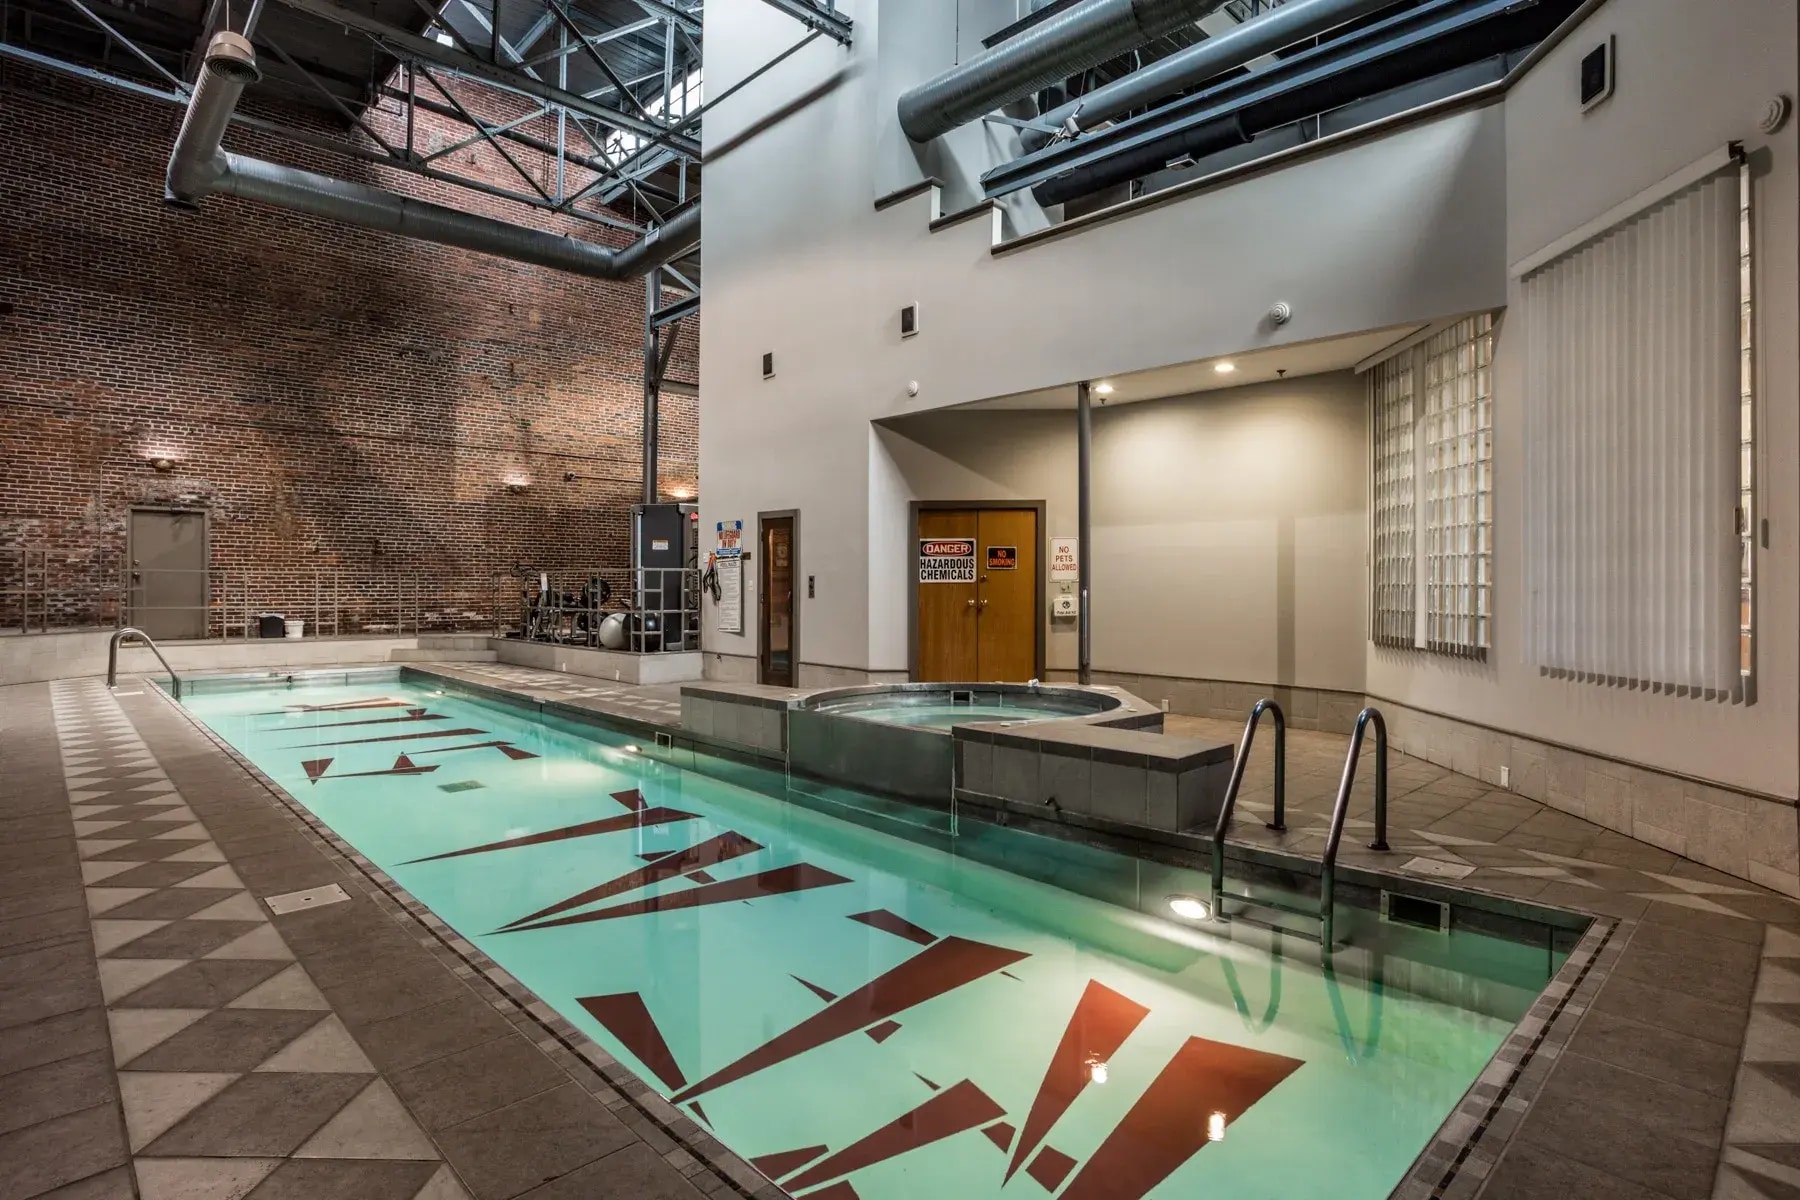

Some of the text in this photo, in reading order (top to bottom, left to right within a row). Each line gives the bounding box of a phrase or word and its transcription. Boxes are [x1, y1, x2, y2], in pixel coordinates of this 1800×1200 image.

[926, 544, 969, 553] DANGER
[1058, 546, 1070, 554] NO
[997, 550, 1007, 558] NO
[920, 558, 975, 569] HAZARDOUS
[989, 558, 1015, 566] SMOKING
[1052, 563, 1077, 571] ALLOWED
[920, 569, 974, 580] CHEMICALS
